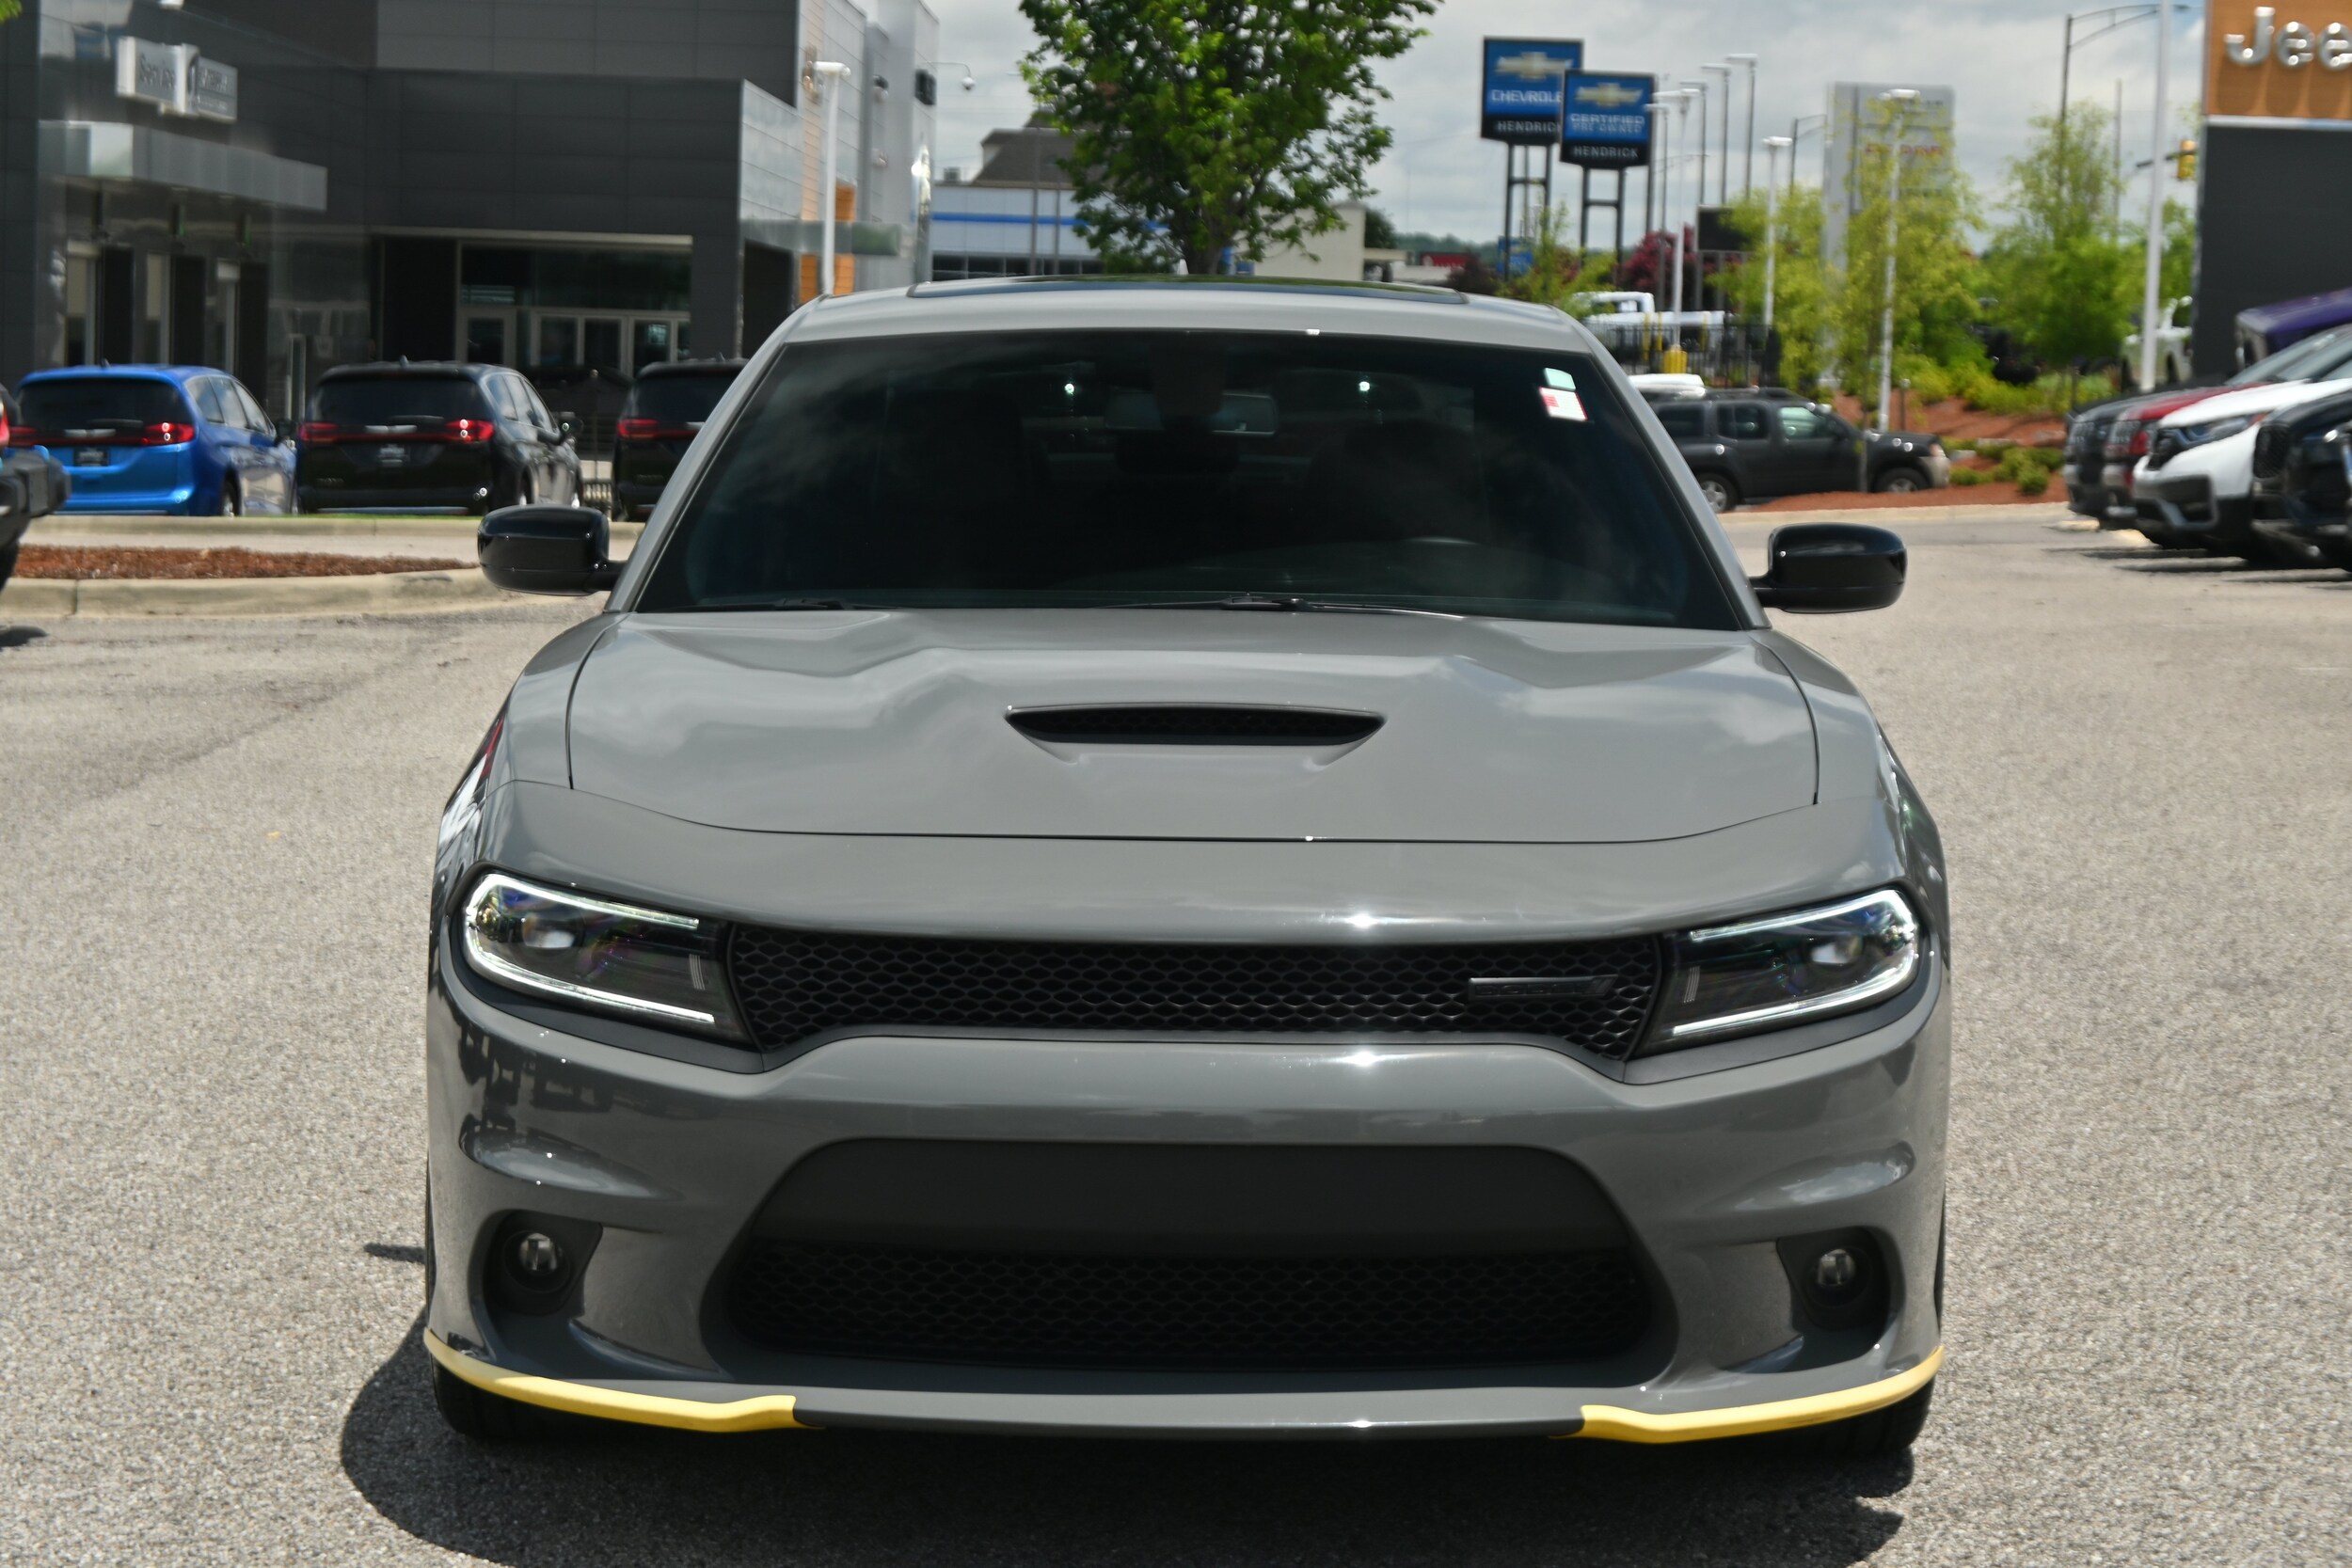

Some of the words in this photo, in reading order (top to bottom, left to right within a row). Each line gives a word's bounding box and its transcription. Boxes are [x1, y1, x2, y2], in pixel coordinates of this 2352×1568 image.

[2224, 6, 2352, 69] Jee
[1490, 89, 1563, 103] CHEVROLE
[1570, 113, 1645, 124] CERTIFIED
[1573, 145, 1640, 160] HENDRICK
